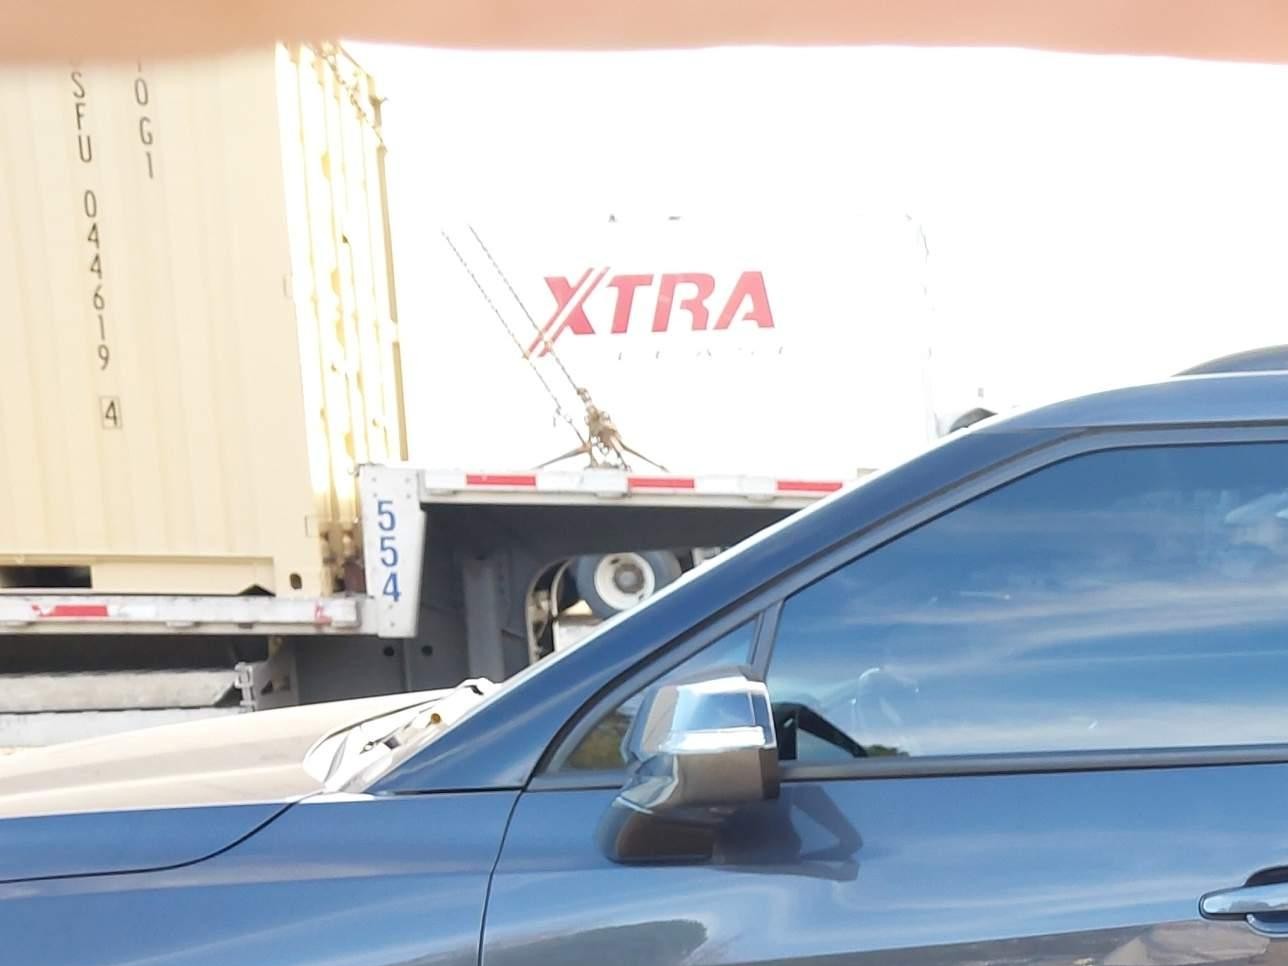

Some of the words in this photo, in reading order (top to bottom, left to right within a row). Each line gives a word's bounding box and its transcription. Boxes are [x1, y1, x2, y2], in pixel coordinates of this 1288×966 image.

[70, 57, 92, 163] SFU
[83, 189, 110, 371] 044619
[104, 399, 118, 428] 4
[523, 266, 776, 358] XTRA
[377, 500, 401, 602] 554
